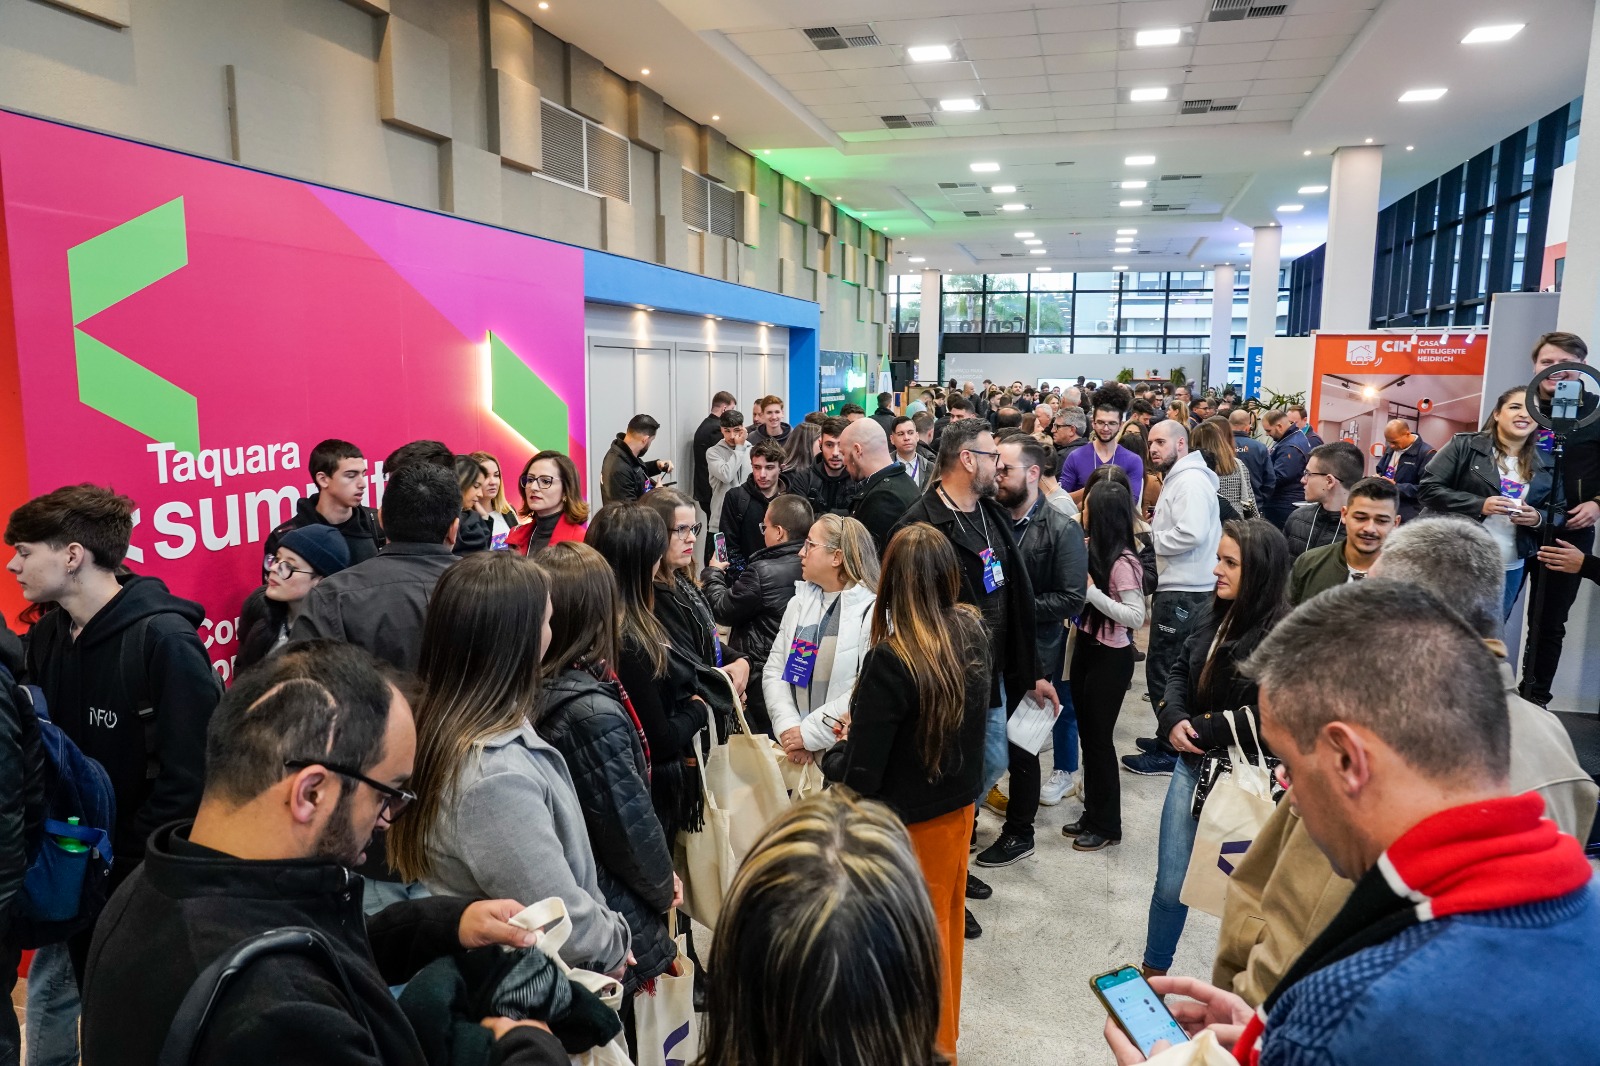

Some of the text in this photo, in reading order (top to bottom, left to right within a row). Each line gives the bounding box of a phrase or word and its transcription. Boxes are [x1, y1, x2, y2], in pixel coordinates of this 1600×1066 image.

[1381, 340, 1412, 352] CIH
[147, 441, 301, 487] Taquara
[153, 458, 390, 560] sumit
